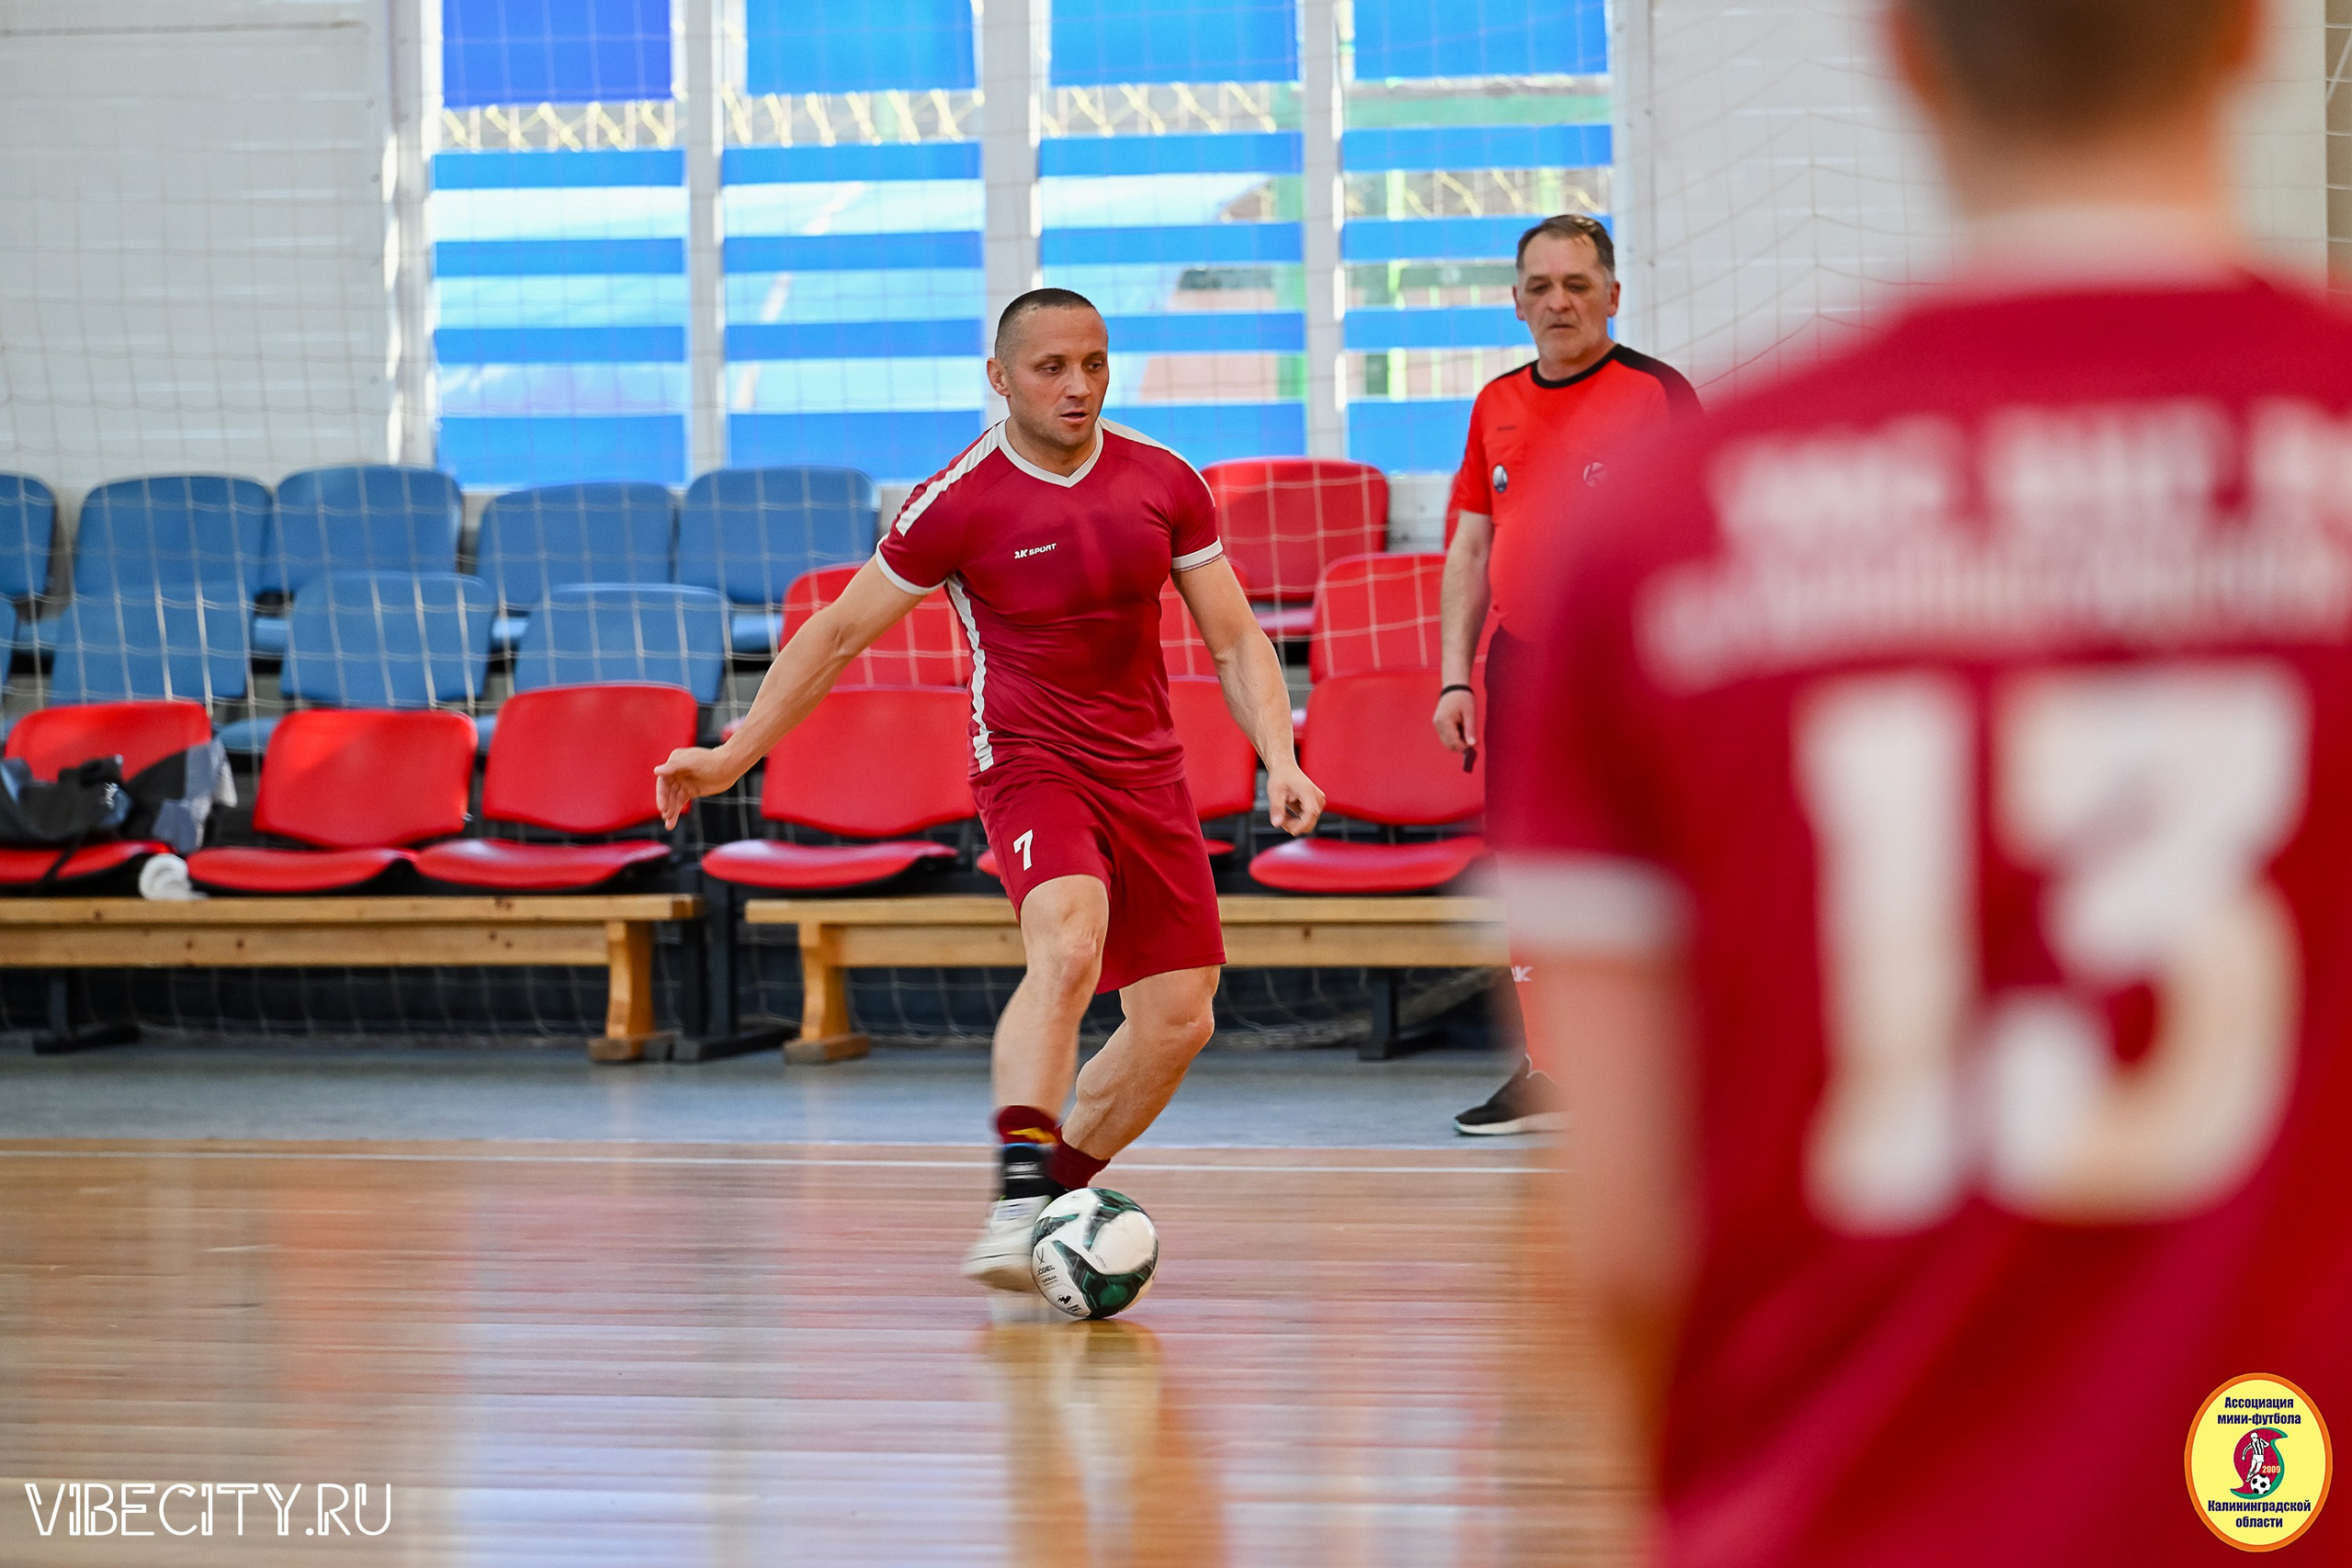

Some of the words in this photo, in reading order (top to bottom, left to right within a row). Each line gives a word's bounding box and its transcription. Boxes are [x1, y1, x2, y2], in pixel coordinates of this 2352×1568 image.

[1029, 543, 1057, 556] SPORT
[1012, 829, 1034, 872] 7
[1796, 671, 2310, 1235] 13
